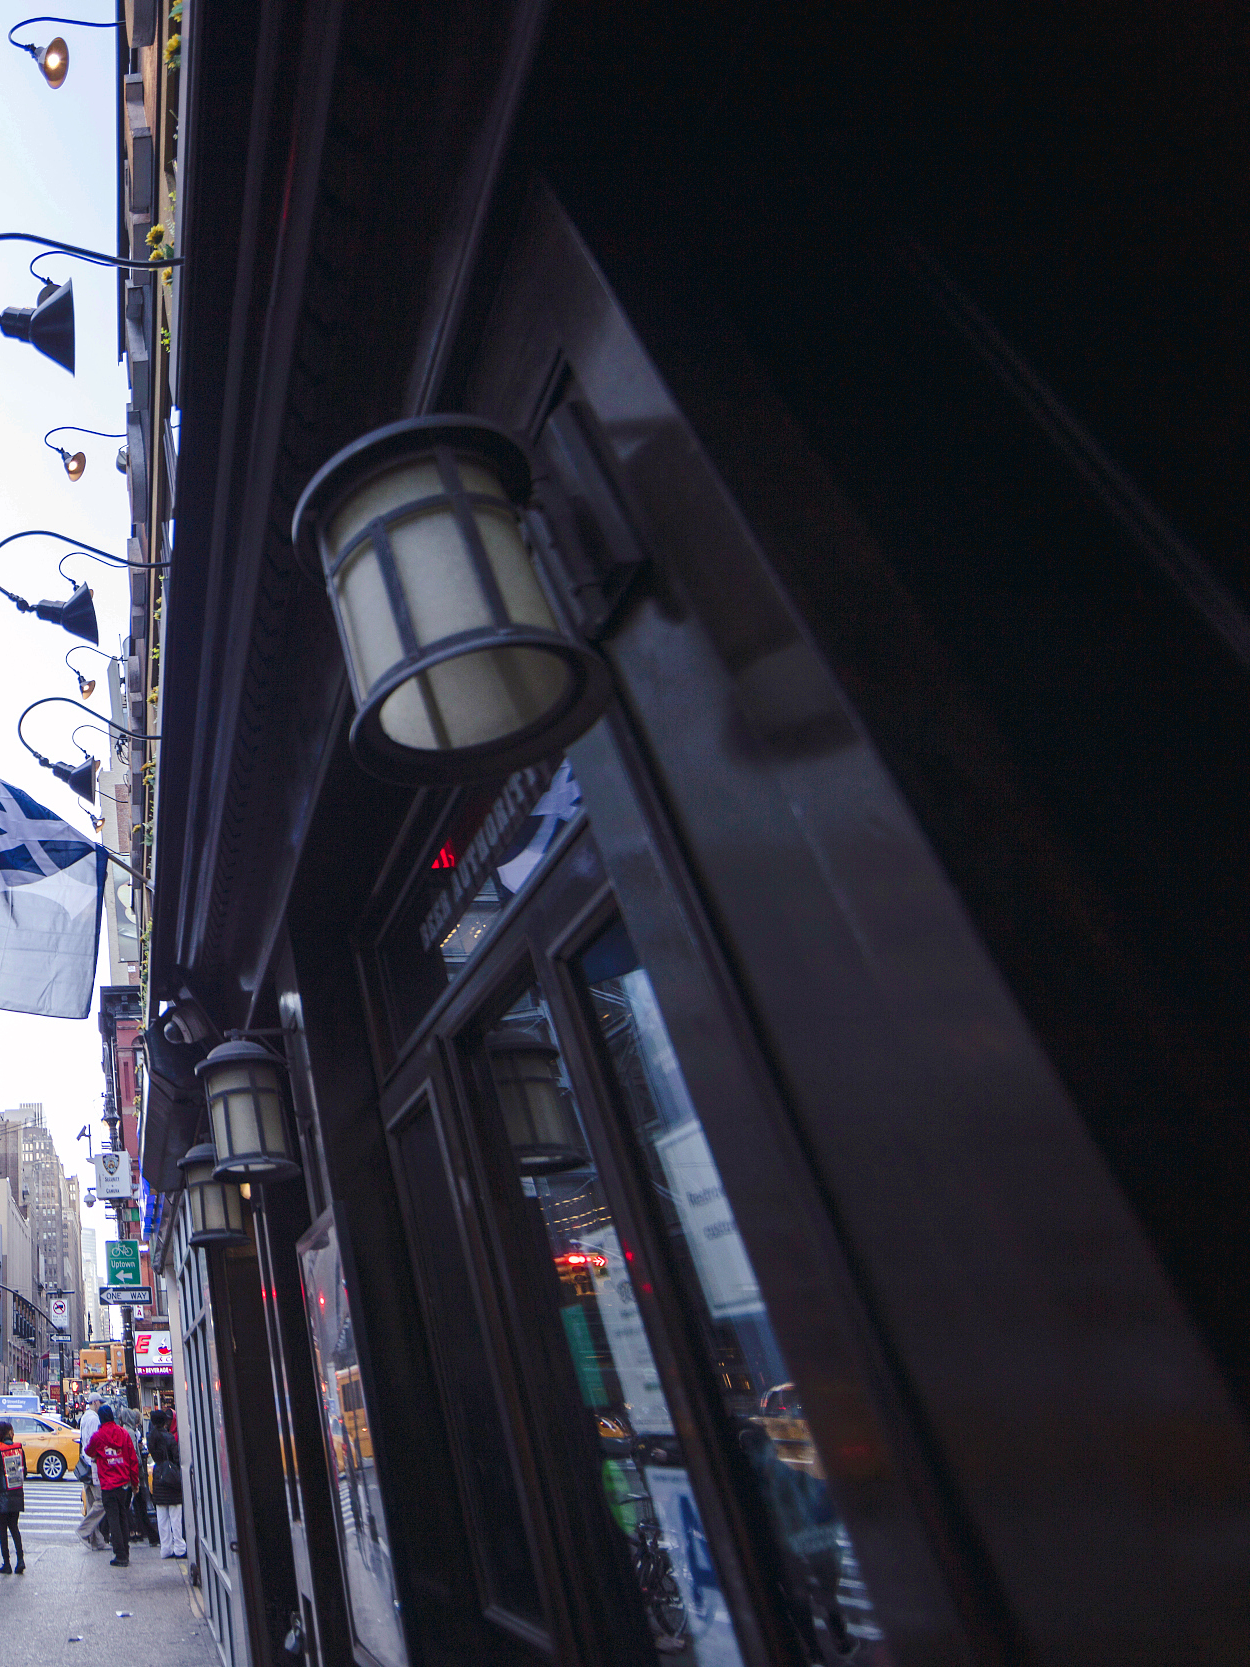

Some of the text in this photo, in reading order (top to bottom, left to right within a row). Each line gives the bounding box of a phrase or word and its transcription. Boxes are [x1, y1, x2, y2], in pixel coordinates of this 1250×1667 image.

[110, 1260, 136, 1269] Uptown
[106, 1292, 147, 1300] ONE WAY
